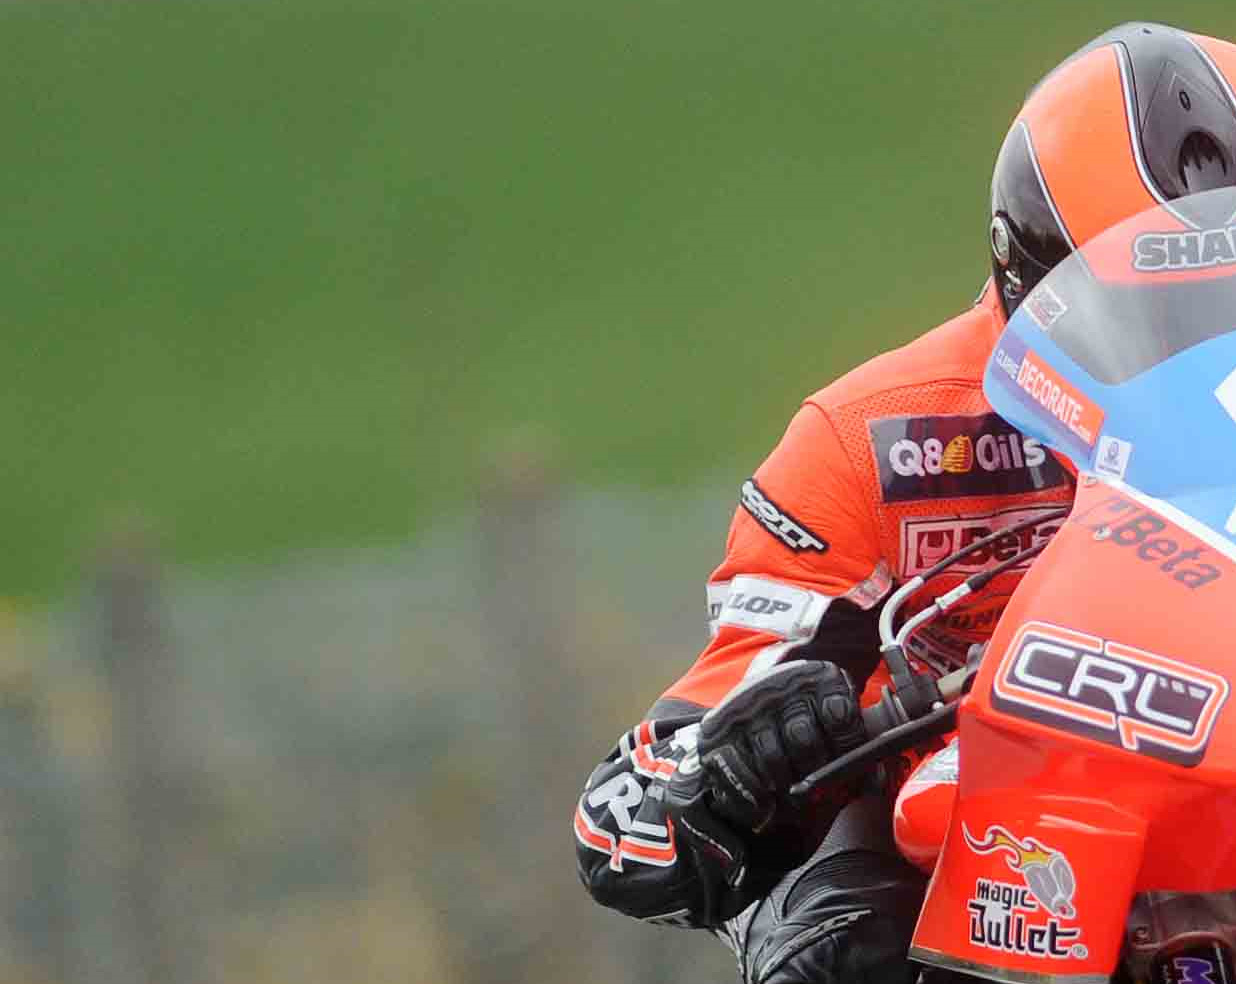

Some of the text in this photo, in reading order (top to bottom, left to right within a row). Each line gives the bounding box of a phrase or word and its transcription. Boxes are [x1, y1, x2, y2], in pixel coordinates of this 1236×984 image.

[889, 435, 1046, 476] Q8 Oils
[1110, 513, 1222, 589] Beta
[1013, 641, 1193, 731] CRL
